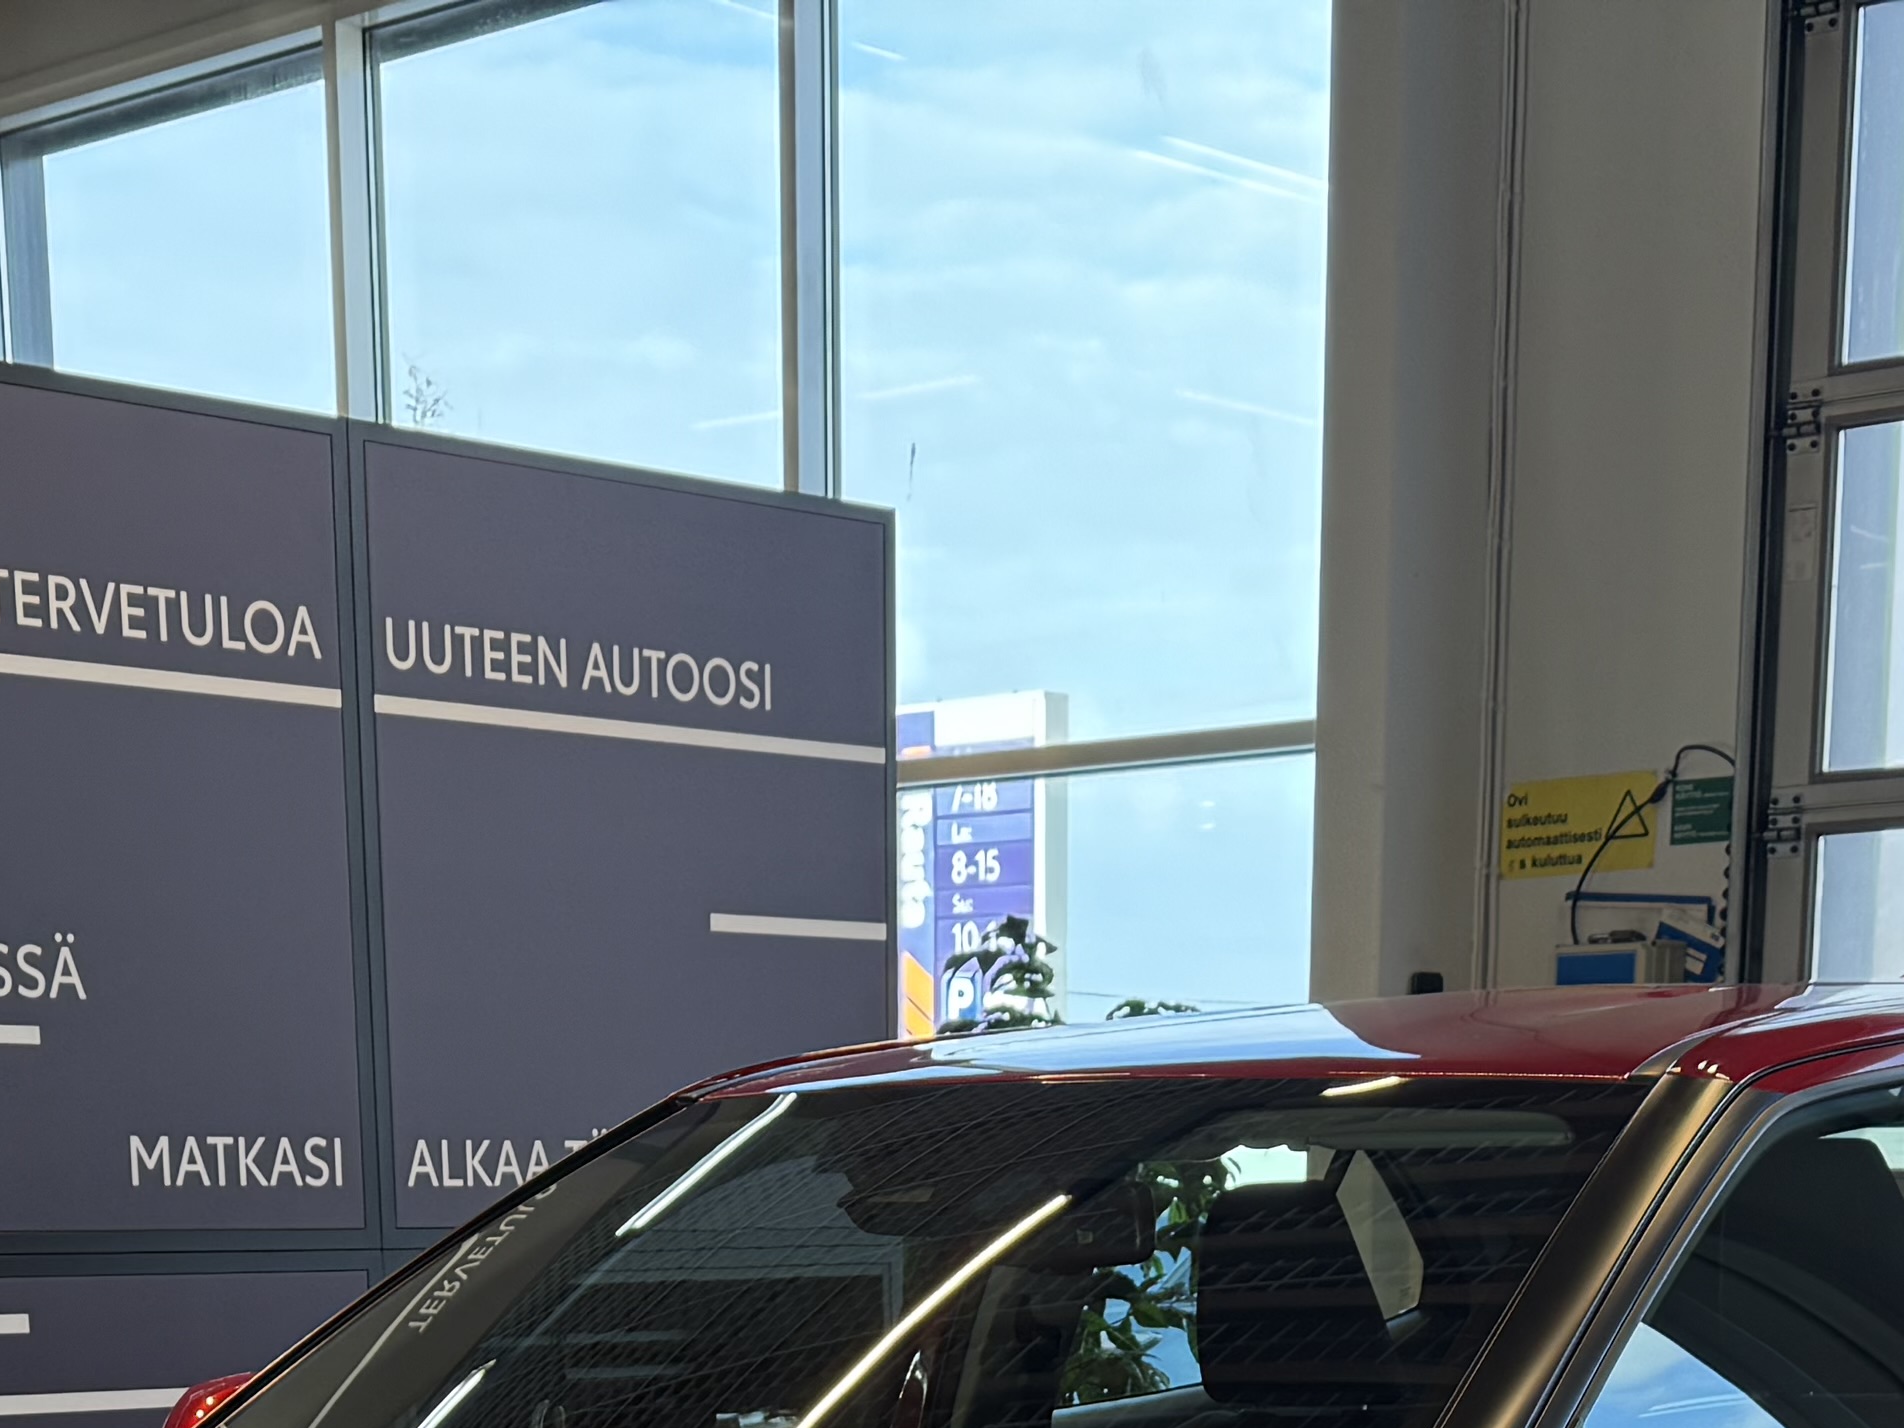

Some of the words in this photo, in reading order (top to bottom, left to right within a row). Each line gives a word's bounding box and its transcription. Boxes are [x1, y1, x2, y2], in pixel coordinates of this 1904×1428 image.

[385, 617, 568, 688] UUTEEN
[581, 641, 772, 711] AUTOOSI
[1507, 792, 1528, 808] Ovi
[951, 848, 1001, 885] 8-15
[129, 1135, 343, 1187] MATKASI
[408, 1139, 549, 1187] ALKAA
